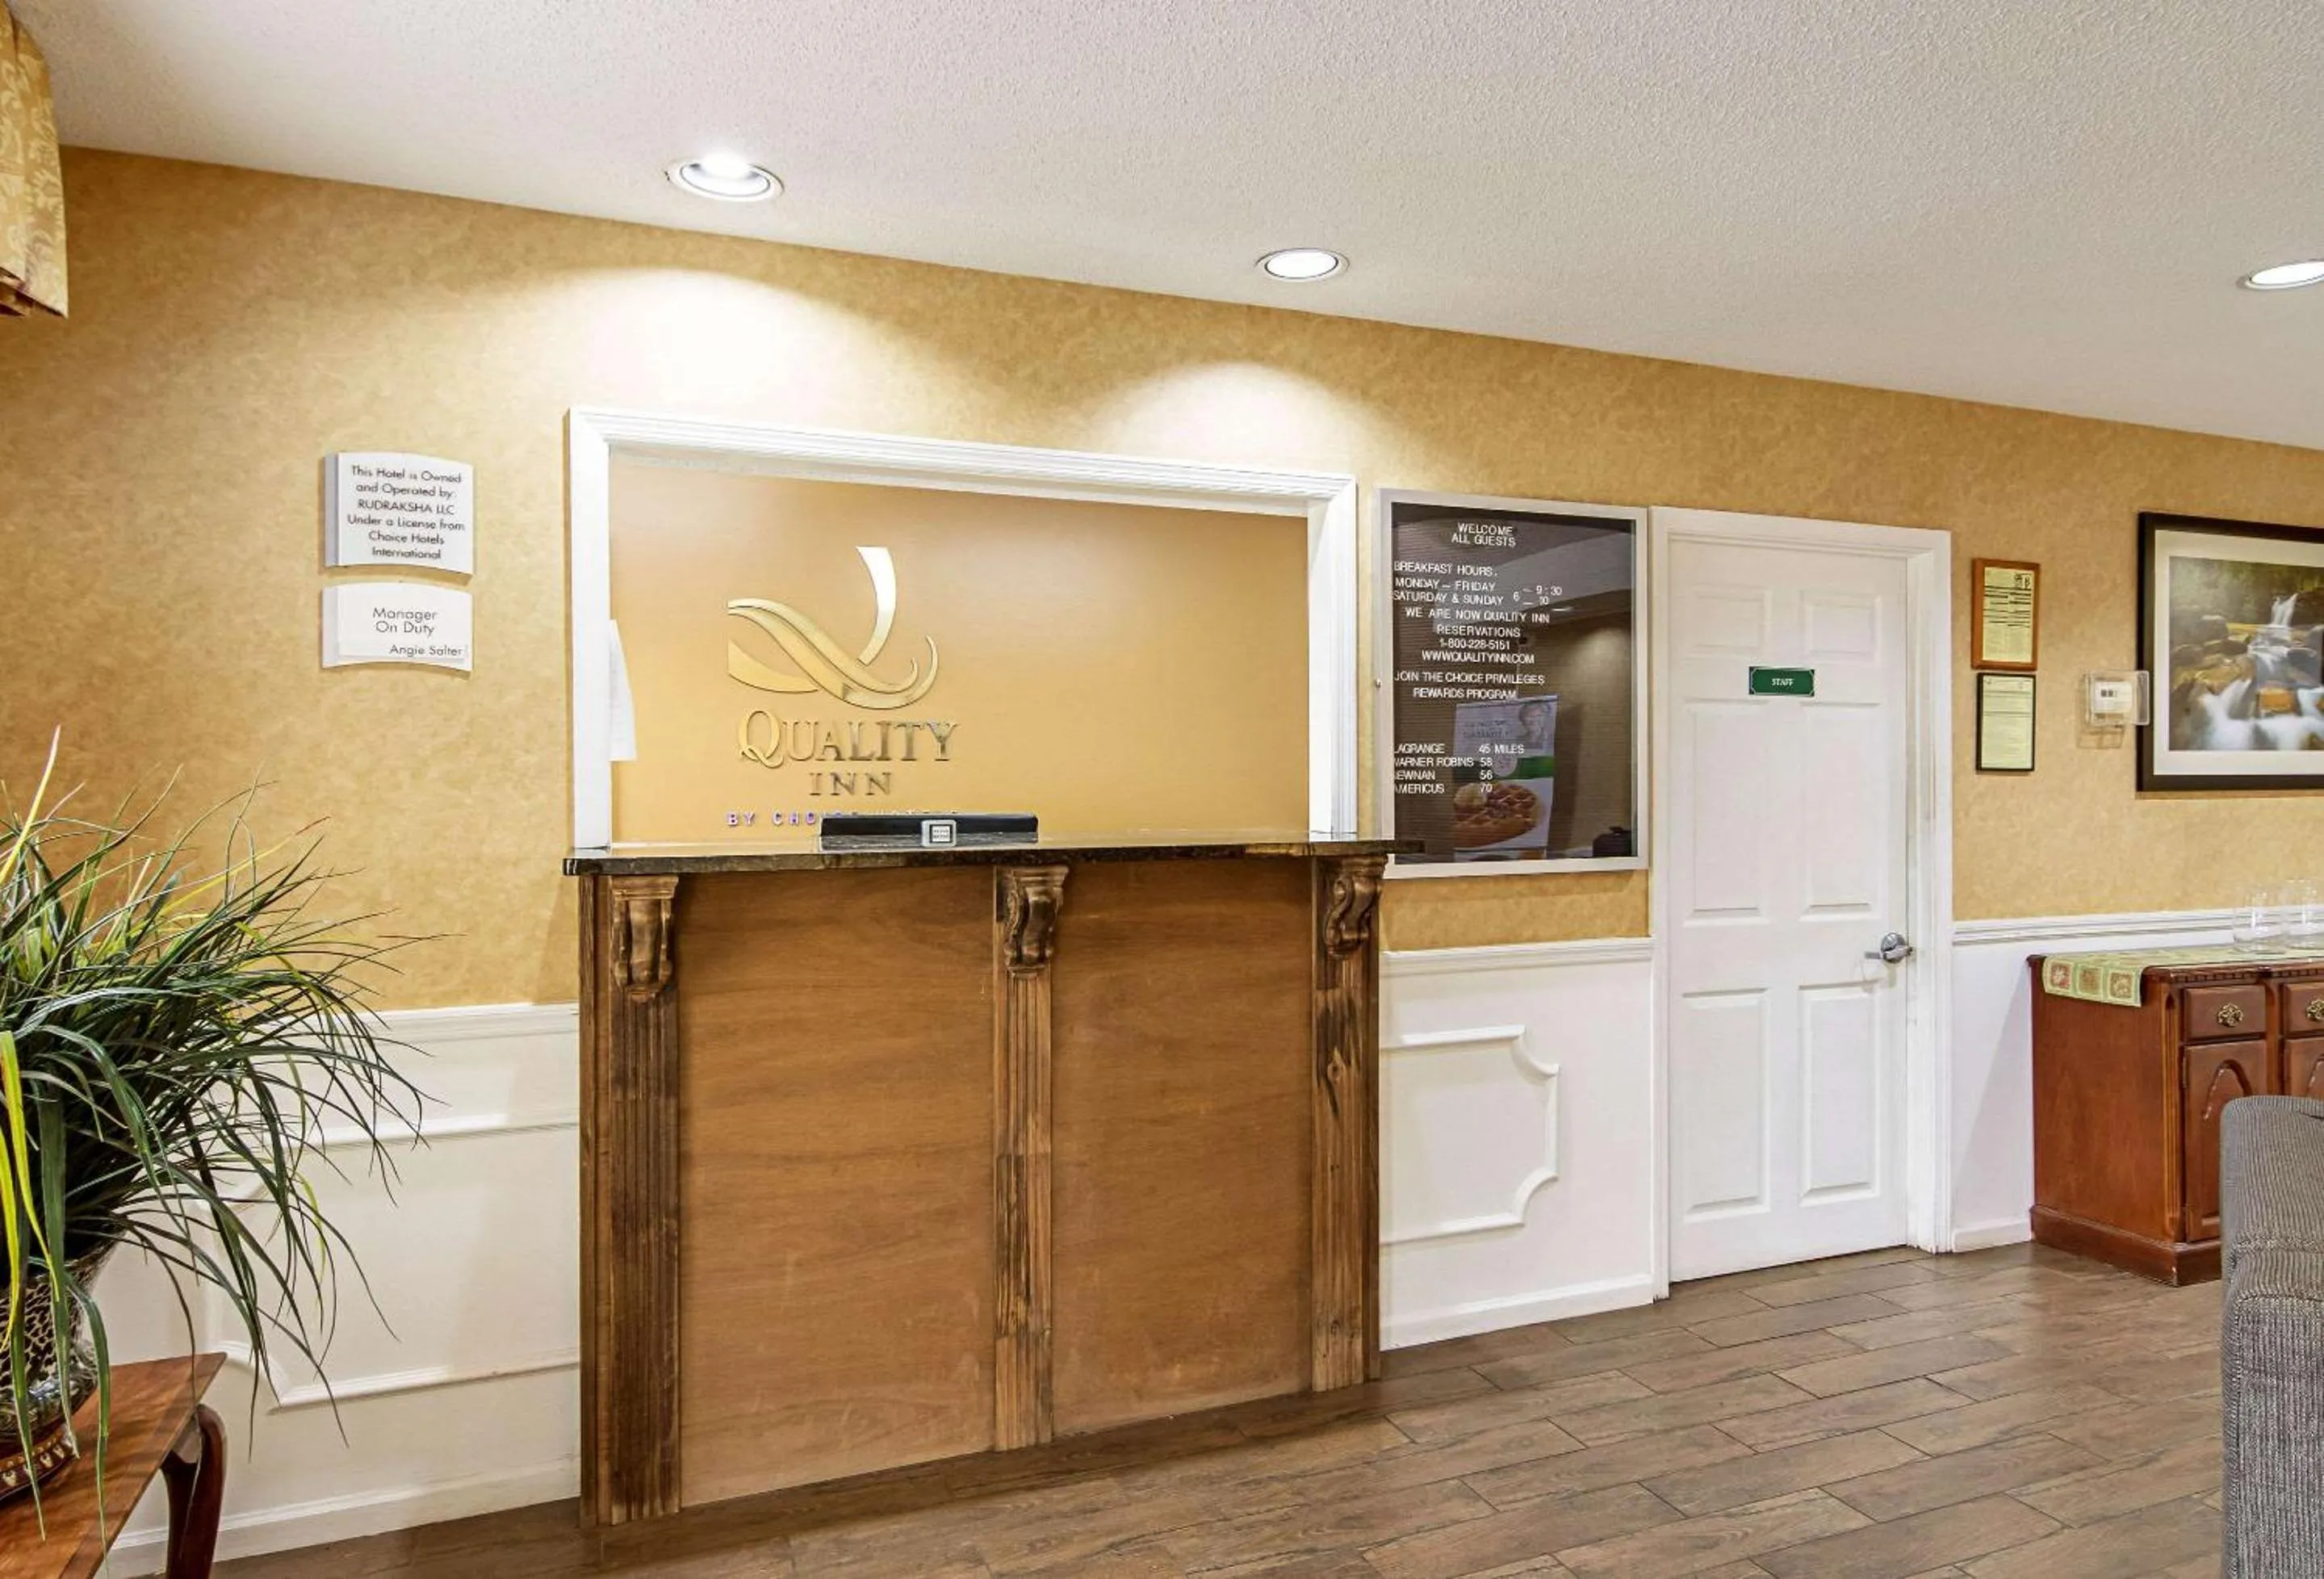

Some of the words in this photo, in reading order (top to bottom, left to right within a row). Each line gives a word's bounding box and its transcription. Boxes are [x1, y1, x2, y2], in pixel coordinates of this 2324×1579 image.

[352, 465, 372, 476] This
[376, 467, 405, 479] Hotel
[410, 472, 417, 480] is
[421, 471, 461, 483] Owned
[356, 483, 379, 492] and
[382, 483, 436, 496] Operated
[358, 499, 433, 513] RUDRAKSHA
[436, 505, 455, 515] LLC
[347, 514, 383, 525] Under
[386, 518, 394, 526] a
[397, 517, 436, 529] License
[439, 518, 466, 530] from
[1457, 522, 1514, 537] WELCOME
[369, 530, 407, 542] Choice
[411, 533, 445, 545] Hotels
[1451, 533, 1471, 544] ALL
[1474, 534, 1516, 547] GUESTS
[372, 547, 442, 559] International
[1394, 561, 1452, 574] BREAKFAST
[1395, 577, 1440, 589] MONDAY
[1455, 580, 1496, 591] FRIDAY
[1392, 589, 1448, 602] SATURDAY
[1451, 593, 1459, 604] &
[1463, 594, 1504, 605] SUNDAY
[1513, 591, 1521, 601] 6
[373, 607, 438, 623] Manager
[1405, 606, 1423, 618] WE
[1428, 609, 1451, 619] ARE
[1455, 609, 1480, 621] NOW
[1484, 611, 1527, 622] QUALITY
[1531, 613, 1550, 624] INN
[376, 621, 397, 633] On
[404, 621, 435, 638] Duty
[1437, 624, 1521, 638] RESERVATIONS
[390, 644, 425, 657] Angie
[429, 645, 463, 655] Salter
[1394, 671, 1420, 683] JOIN
[1422, 672, 1443, 683] THE
[1445, 672, 1484, 684] CHOICE
[1485, 673, 1546, 686] PRIVILEGES
[1771, 678, 1795, 687] STAFF
[1413, 687, 1465, 699] REWARDS
[1467, 689, 1518, 701] PROGRAM
[738, 710, 959, 769] QUALITY
[1479, 743, 1491, 754] 45
[1494, 743, 1525, 754] MILES
[1437, 757, 1475, 768] ROBINS
[1480, 757, 1493, 768] 58
[1395, 769, 1436, 781] EWNAN
[1480, 769, 1493, 781] 56
[809, 772, 892, 796] INN
[1480, 782, 1493, 794] 70
[727, 811, 756, 827] BY
